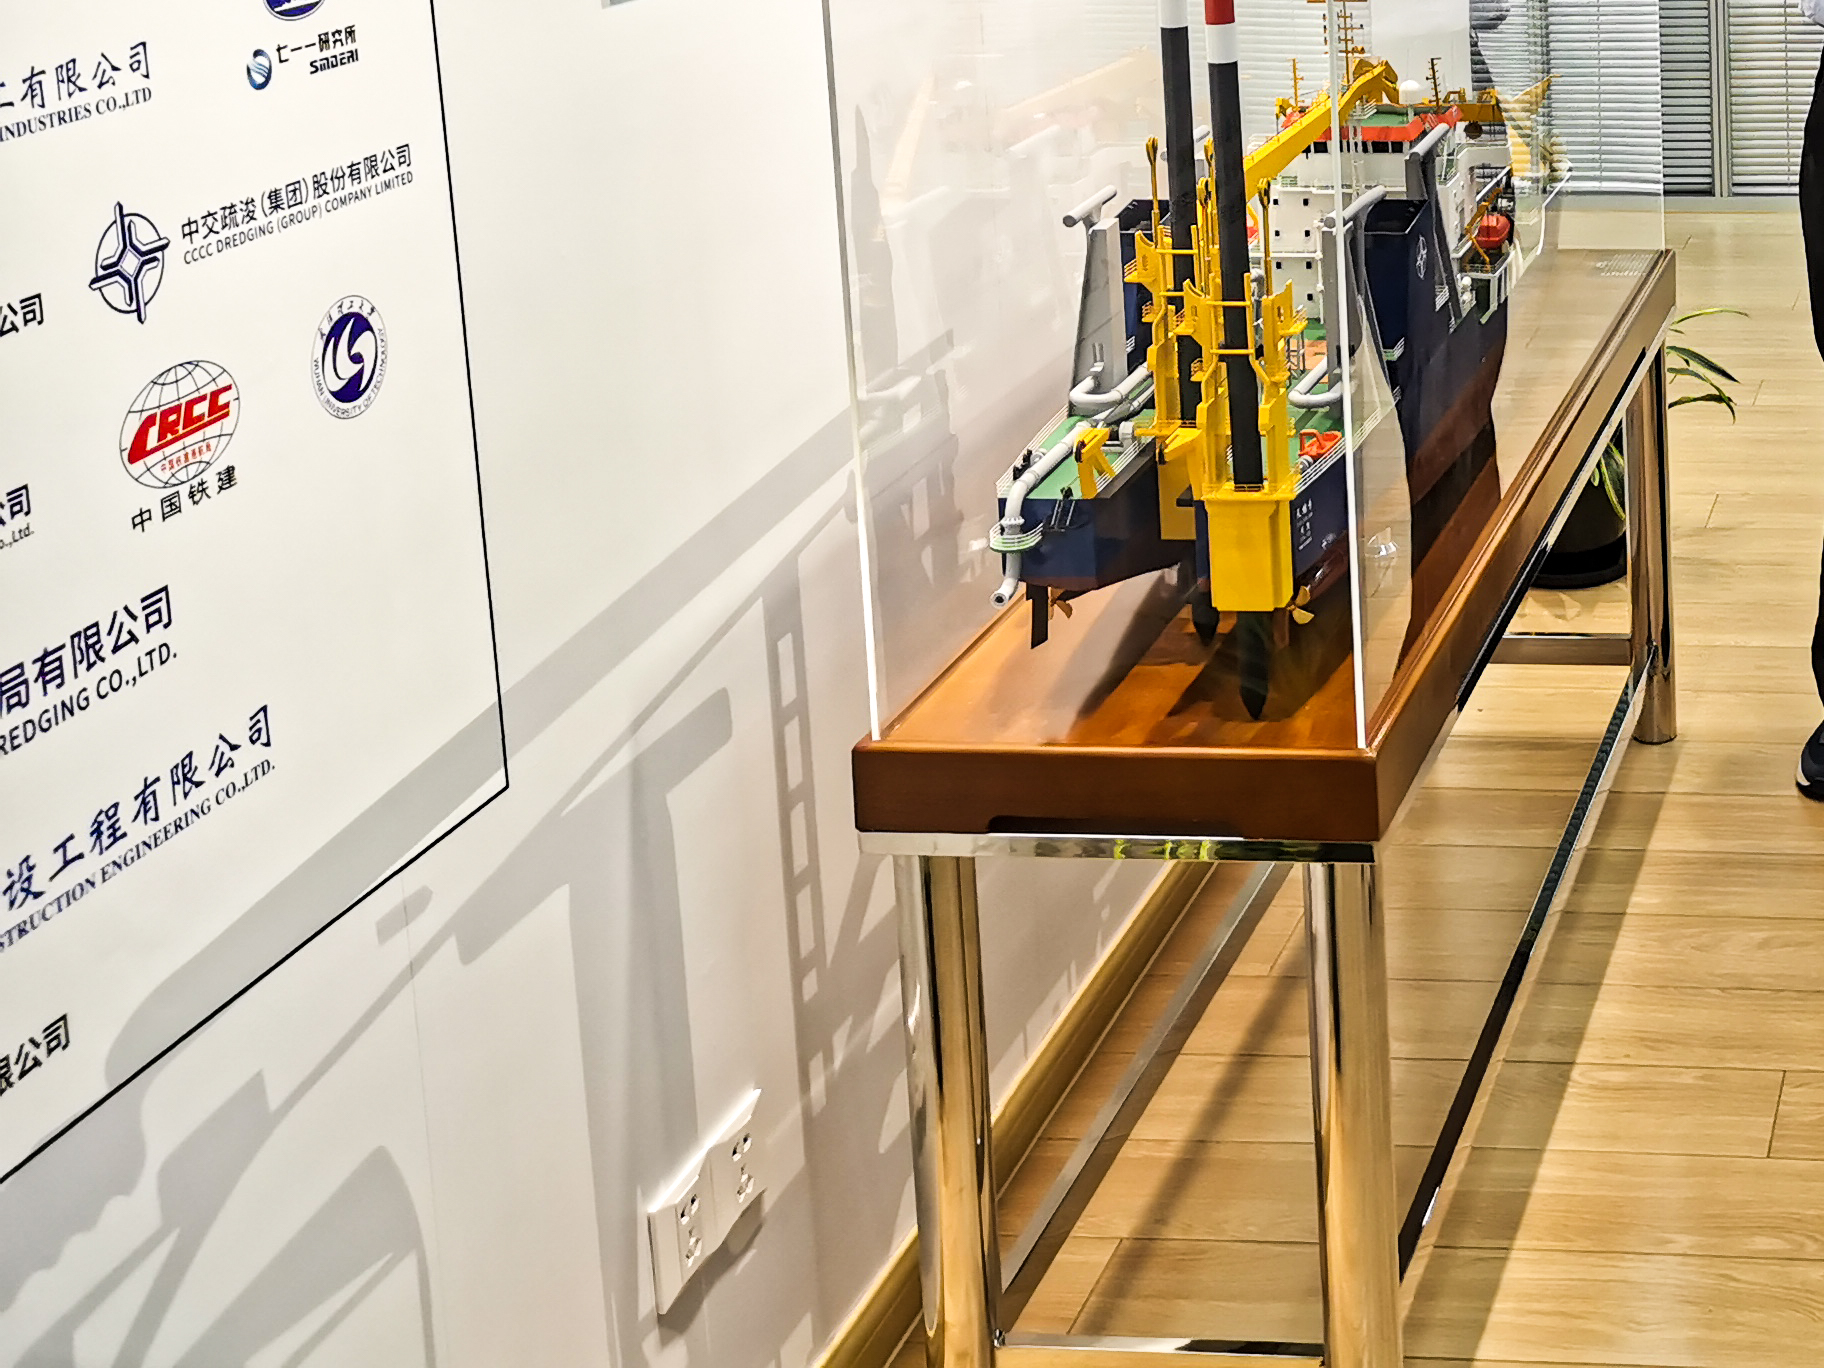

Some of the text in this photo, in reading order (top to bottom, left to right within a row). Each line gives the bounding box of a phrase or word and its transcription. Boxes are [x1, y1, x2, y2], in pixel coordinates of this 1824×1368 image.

[276, 24, 356, 64] 七一一研究所
[95, 86, 152, 115] CO.,LTD
[184, 170, 414, 265] CCCC DREDGING (GROUP) COMPANY LIMITED
[0, 293, 44, 337] 公司
[128, 383, 233, 465] CRCC
[0, 483, 31, 527] 司
[131, 465, 237, 533] 中国铁建
[0, 584, 173, 719] 局有限公司
[96, 642, 177, 700] CO.,LTD.
[2, 704, 272, 911] 设工程有限公司
[100, 798, 212, 884] ENGINEERING
[215, 759, 276, 806] CO.,LTD.
